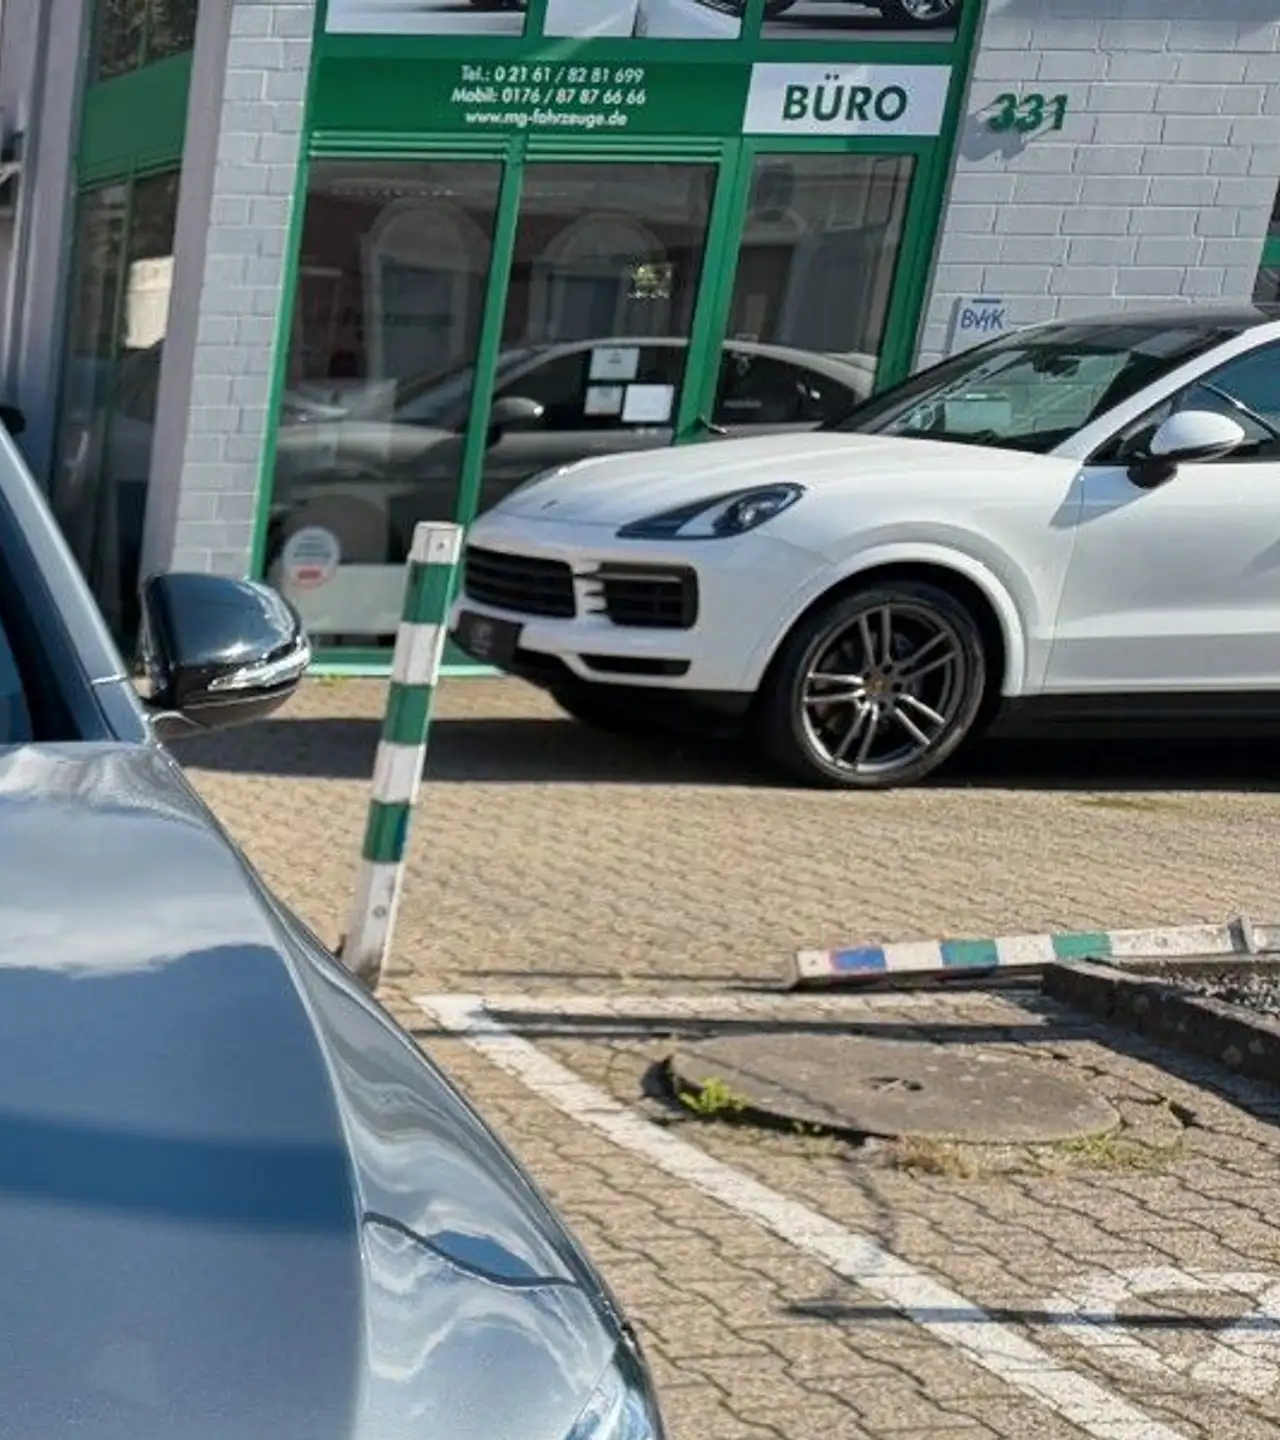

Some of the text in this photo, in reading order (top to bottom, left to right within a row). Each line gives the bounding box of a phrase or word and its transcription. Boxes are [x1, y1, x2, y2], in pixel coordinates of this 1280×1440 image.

[461, 65, 490, 82] Tel.:
[532, 66, 551, 83] 61
[555, 67, 565, 84] /
[568, 67, 587, 83] 82
[591, 67, 610, 83] 81
[615, 67, 645, 84] 699
[452, 87, 646, 105] Mobil: 0176 / 87 87 66 66
[783, 73, 908, 122] BÜRO
[465, 107, 628, 129] www.mg-fahrzeuge.de
[989, 93, 1068, 132] 331
